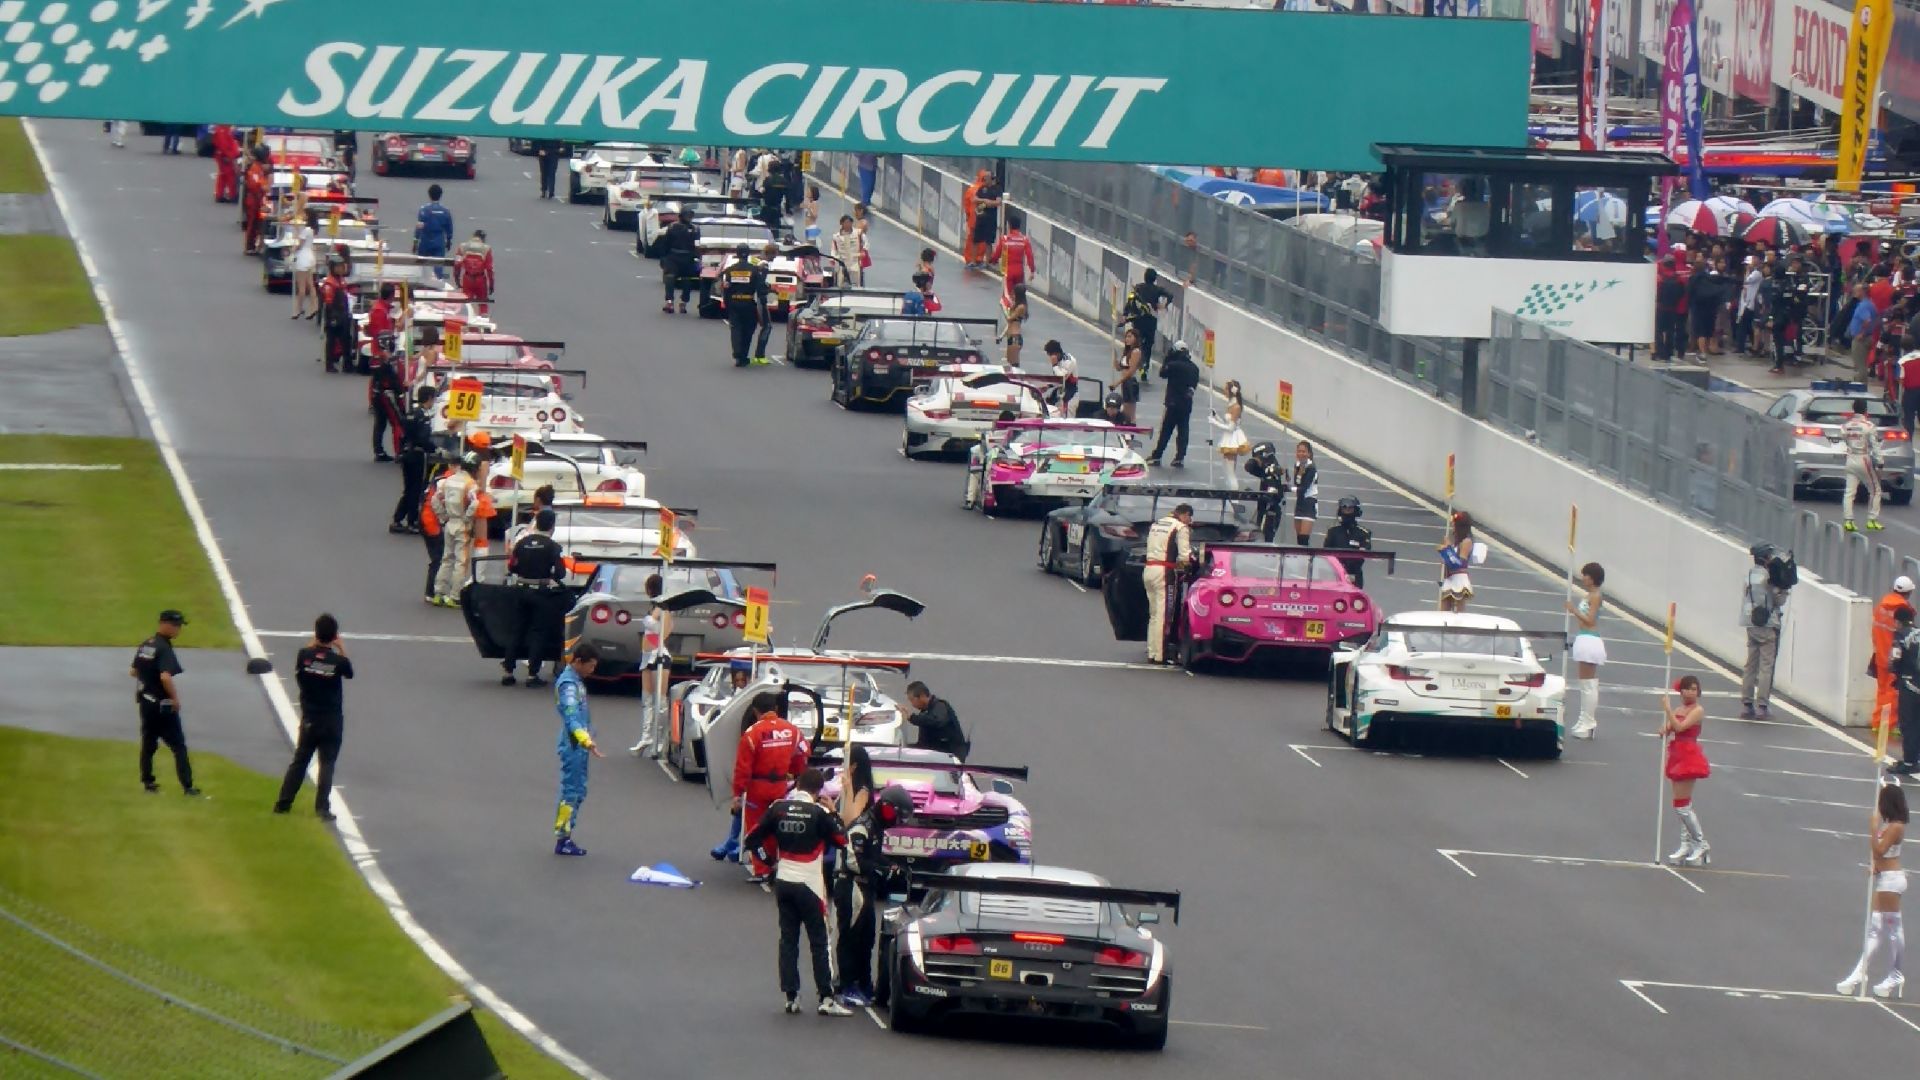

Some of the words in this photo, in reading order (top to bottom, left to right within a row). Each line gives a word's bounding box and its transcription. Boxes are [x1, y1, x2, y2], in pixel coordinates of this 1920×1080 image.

[1791, 5, 1848, 100] HOND
[277, 41, 709, 132] SUZUKA
[721, 62, 1169, 149] CIRCUIT
[456, 392, 477, 411] 50
[1307, 623, 1324, 635] 48
[975, 842, 988, 858] 9
